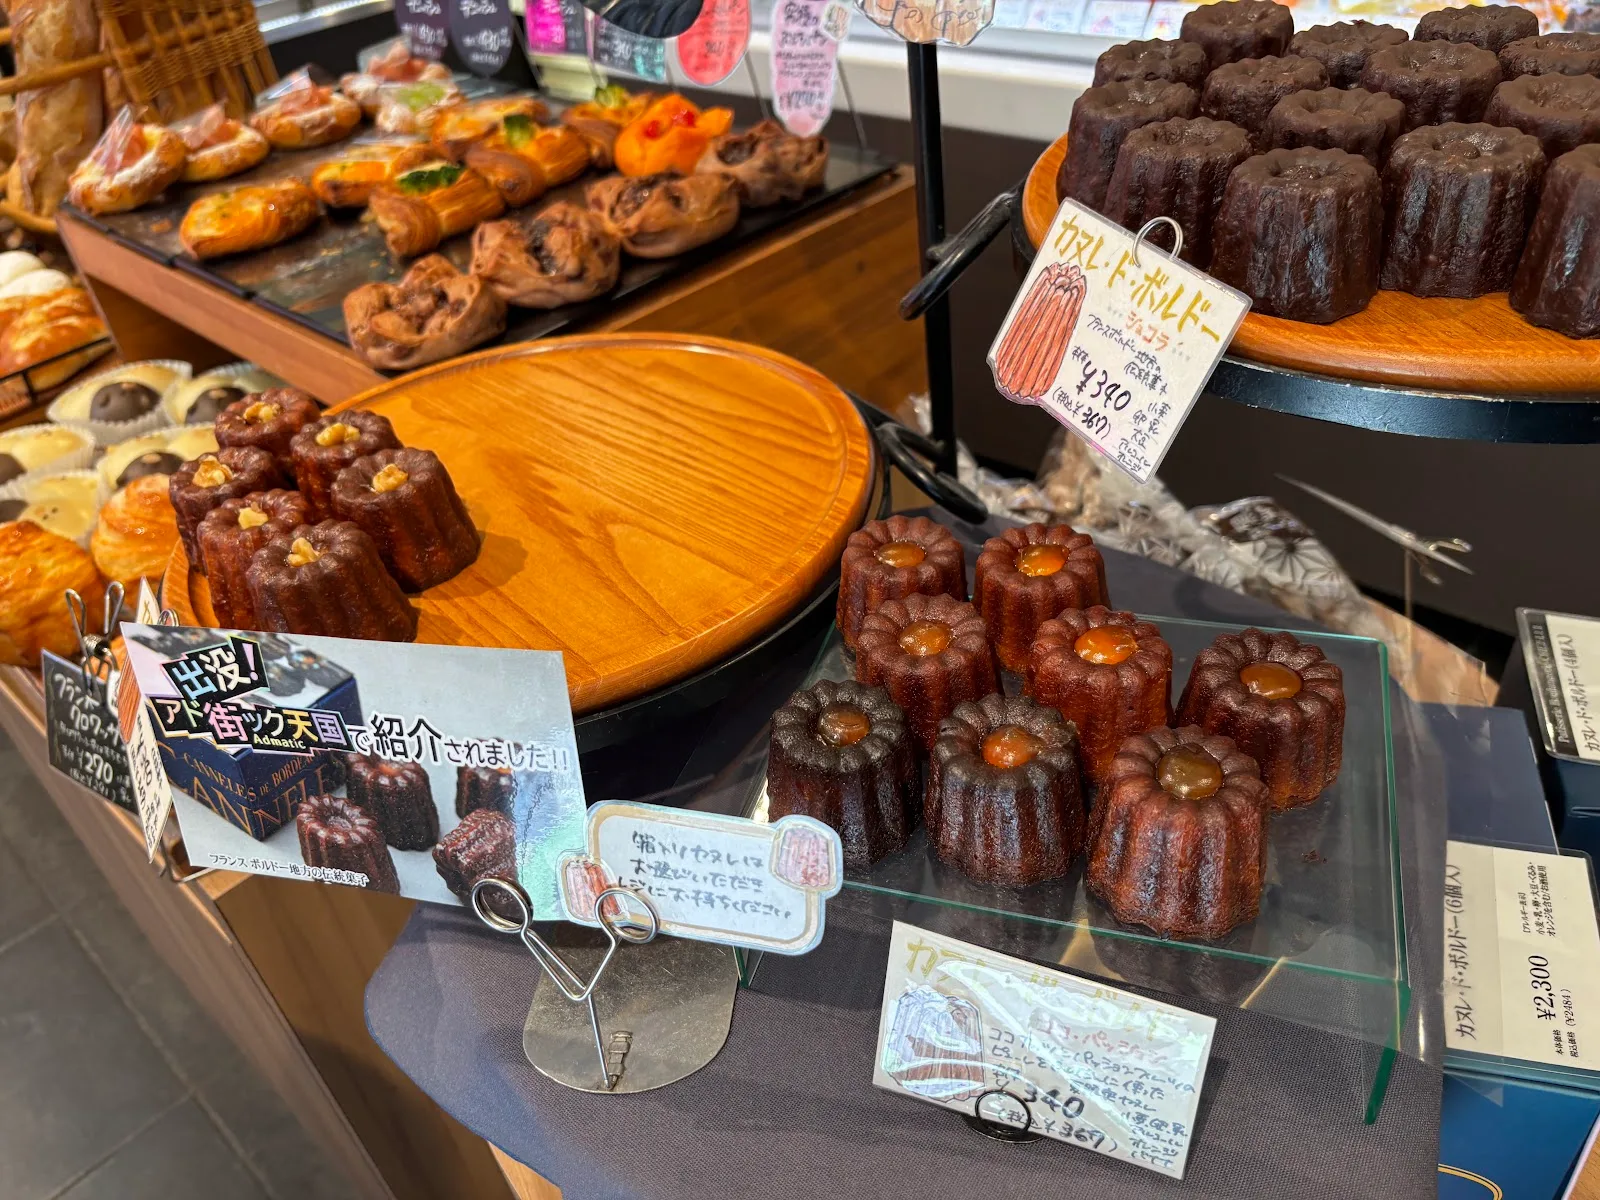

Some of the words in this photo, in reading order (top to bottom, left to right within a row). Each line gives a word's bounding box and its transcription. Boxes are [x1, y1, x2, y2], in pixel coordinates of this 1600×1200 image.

[1124, 311, 1170, 351] ショコラ
[171, 642, 259, 701] 出没!
[155, 699, 348, 746] アド街ック天国
[254, 734, 306, 750] Admatic
[632, 830, 764, 869] 箱入りカヌレは
[209, 854, 248, 868] フランス
[250, 859, 369, 887] ボルドー地方の伝統菓子
[629, 858, 765, 893] お選びいただき
[1527, 955, 1557, 1021] ¥2,300
